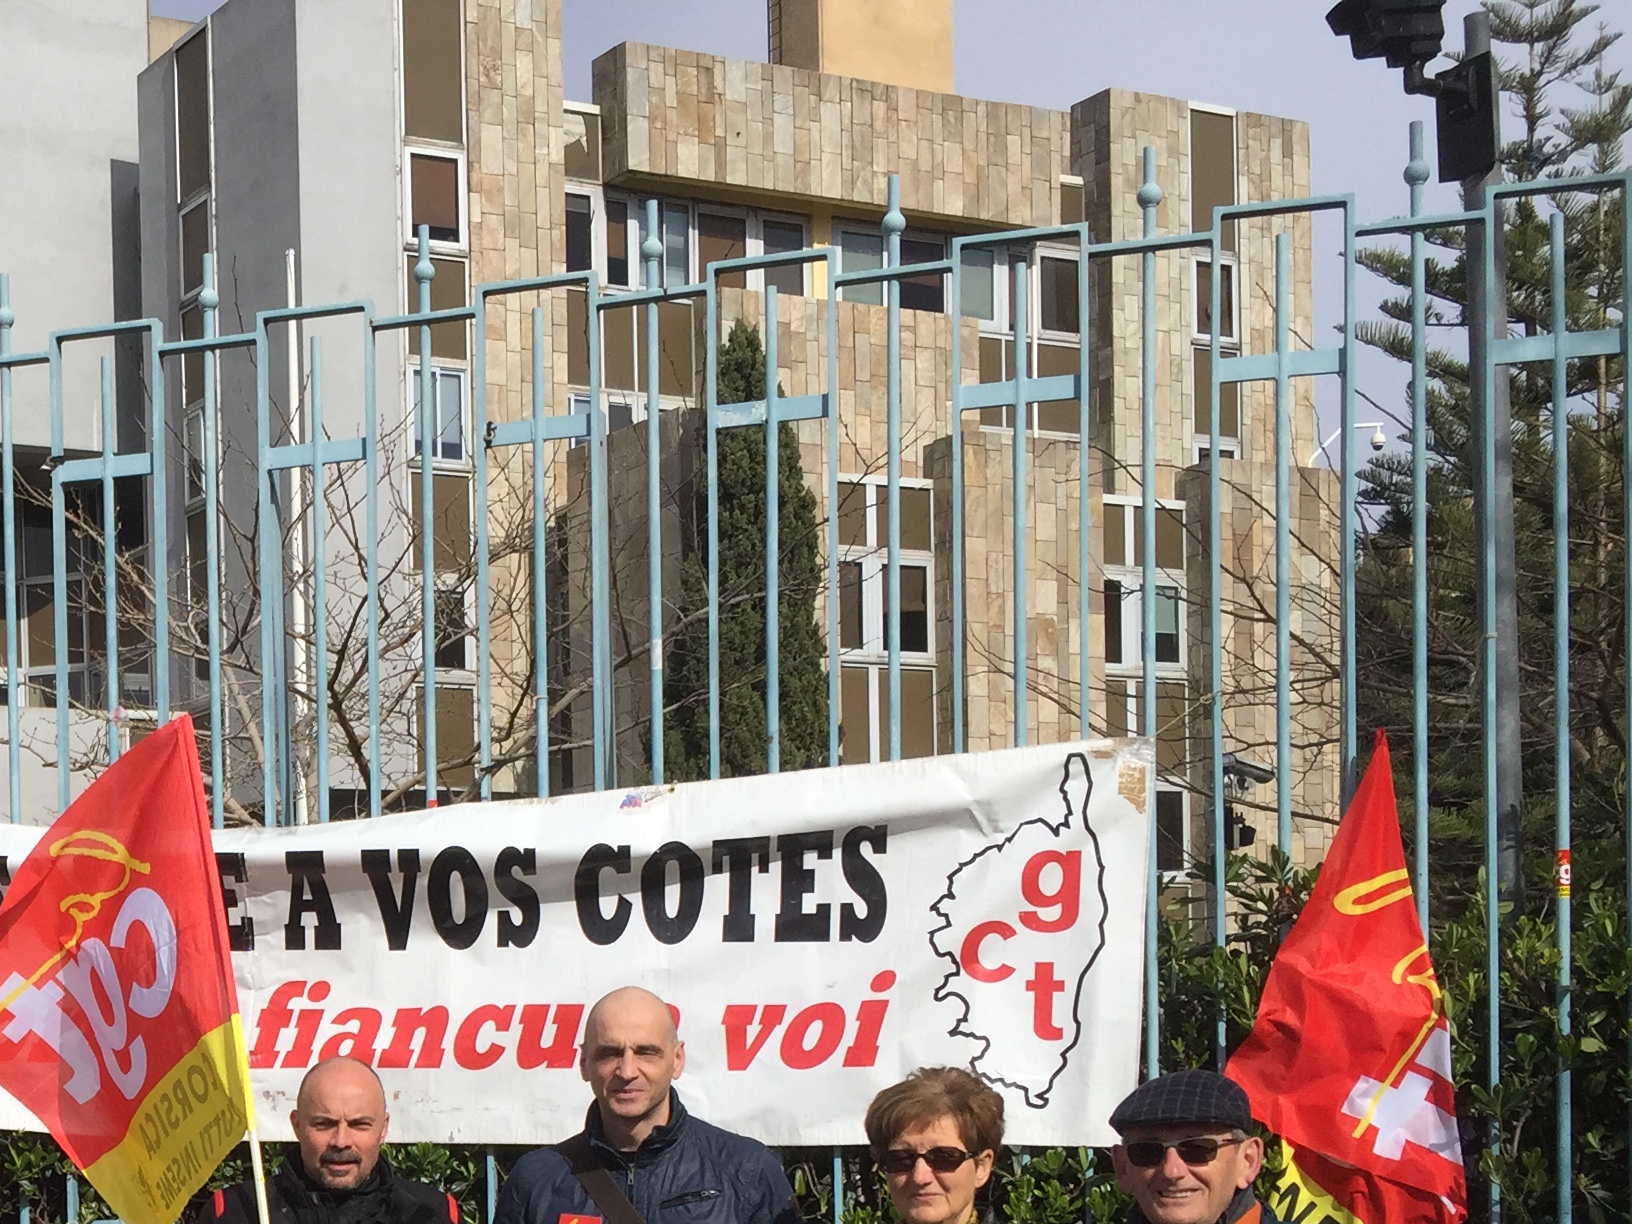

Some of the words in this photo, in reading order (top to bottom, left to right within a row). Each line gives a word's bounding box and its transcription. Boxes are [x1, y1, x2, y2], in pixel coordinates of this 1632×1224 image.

[284, 850, 342, 951] A
[360, 845, 540, 951] VOS
[574, 824, 889, 945] COTES
[721, 969, 897, 1072] voi
